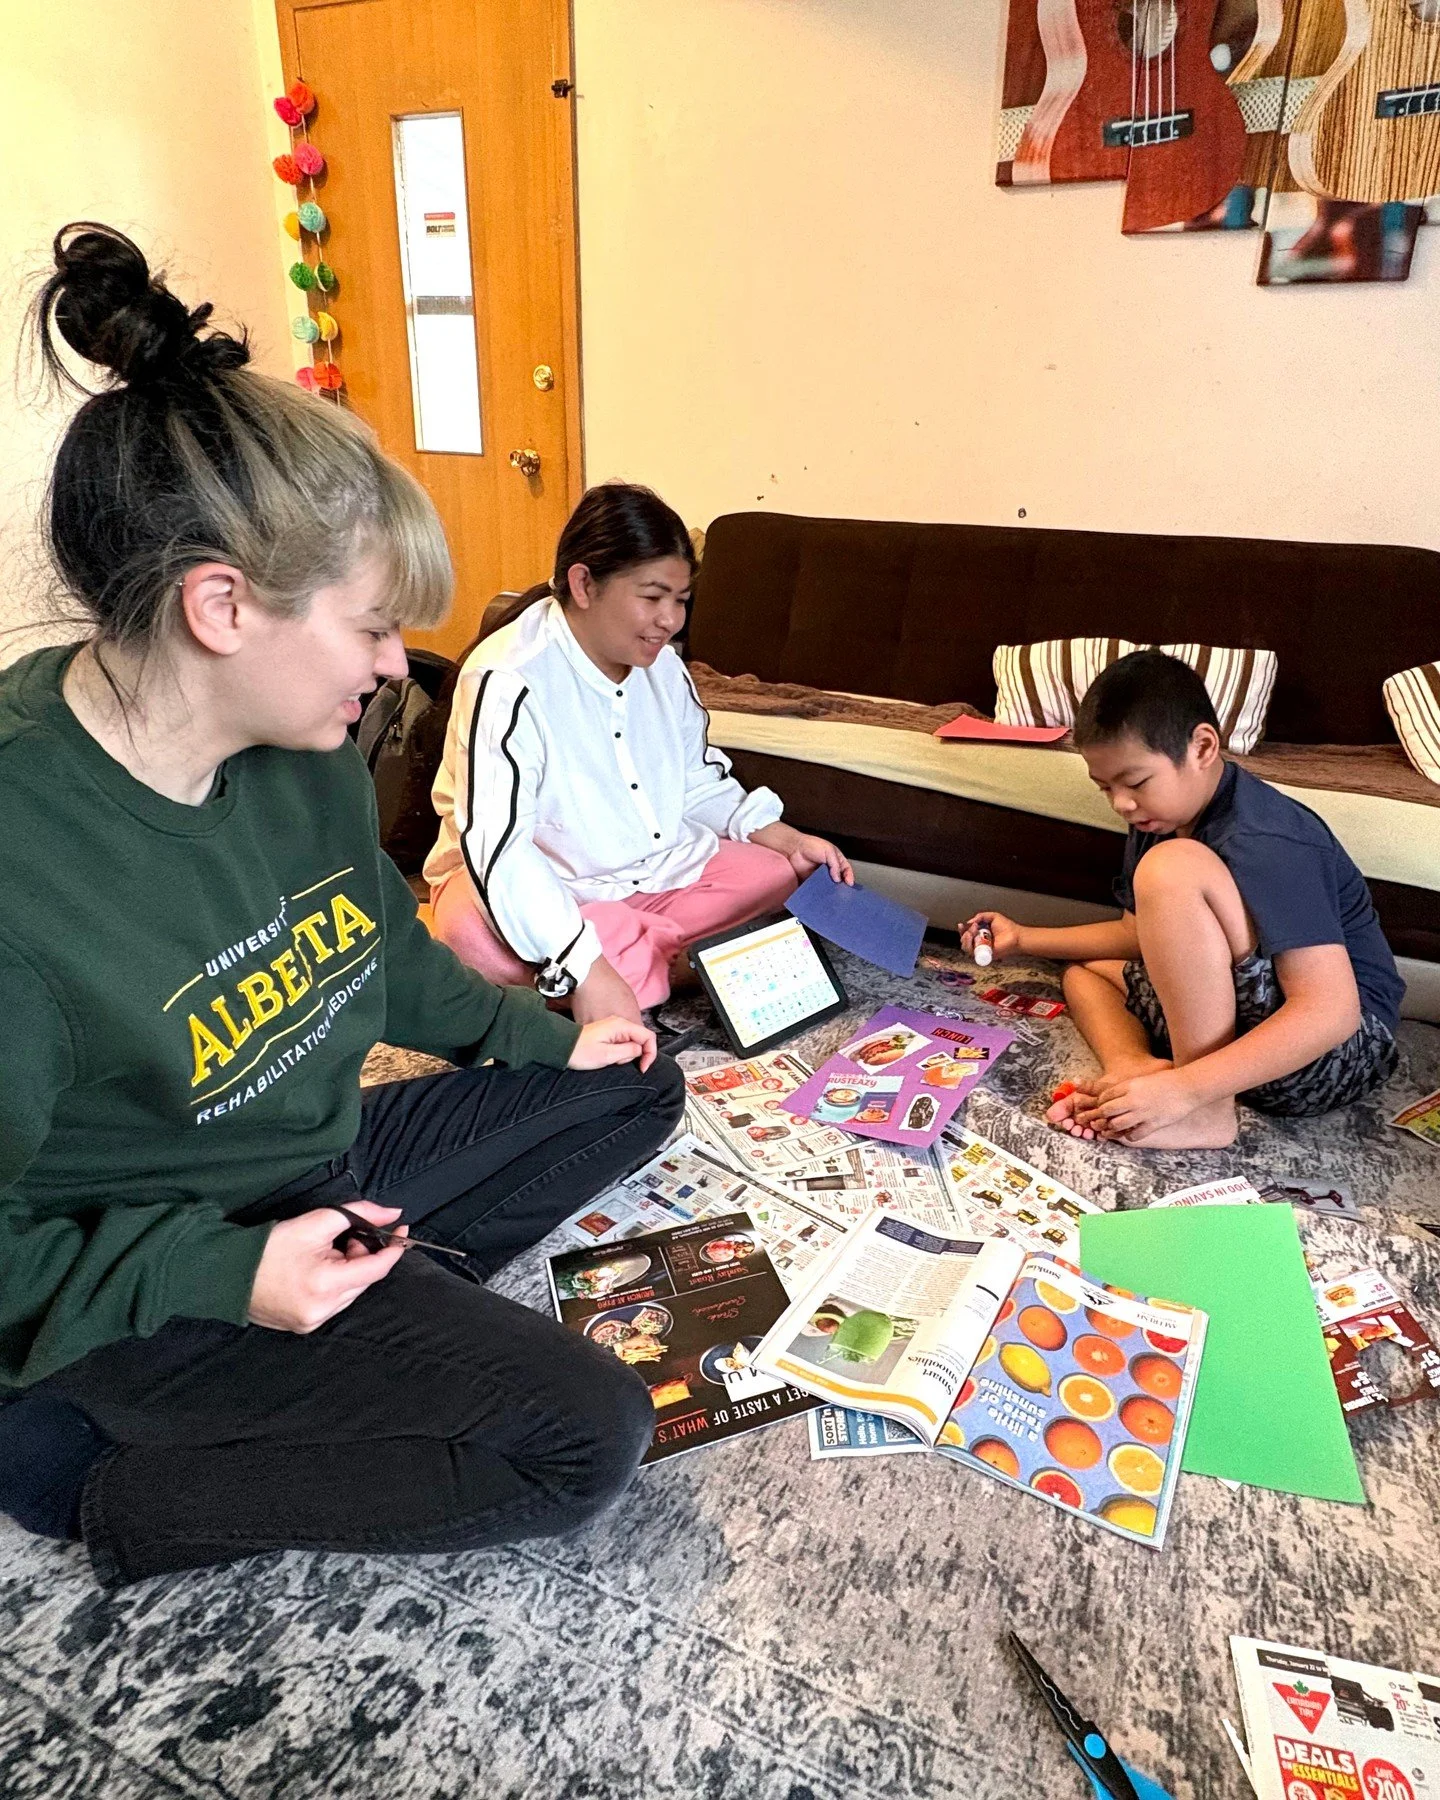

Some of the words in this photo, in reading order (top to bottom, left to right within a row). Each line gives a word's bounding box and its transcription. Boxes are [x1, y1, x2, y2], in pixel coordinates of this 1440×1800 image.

[188, 893, 377, 1088] ALBETA
[933, 1028, 973, 1043] LUNCH
[1169, 1191, 1214, 1208] SAVING
[1213, 1187, 1228, 1199] IN
[922, 1369, 954, 1395] Smart
[734, 1397, 771, 1418] TASTE
[773, 1393, 782, 1405] A
[978, 1377, 1047, 1420] sunshine
[979, 1390, 999, 1405] of
[657, 1417, 709, 1443] WHAT'S
[713, 1410, 730, 1425] OF
[835, 1410, 848, 1442] STORE
[987, 1406, 1025, 1438] little
[1003, 1401, 1042, 1433] taste
[824, 1419, 835, 1445] SORT
[1027, 1428, 1039, 1443] a
[1277, 1738, 1355, 1775] DEALS
[1292, 1762, 1359, 1792] ESSENTIALS
